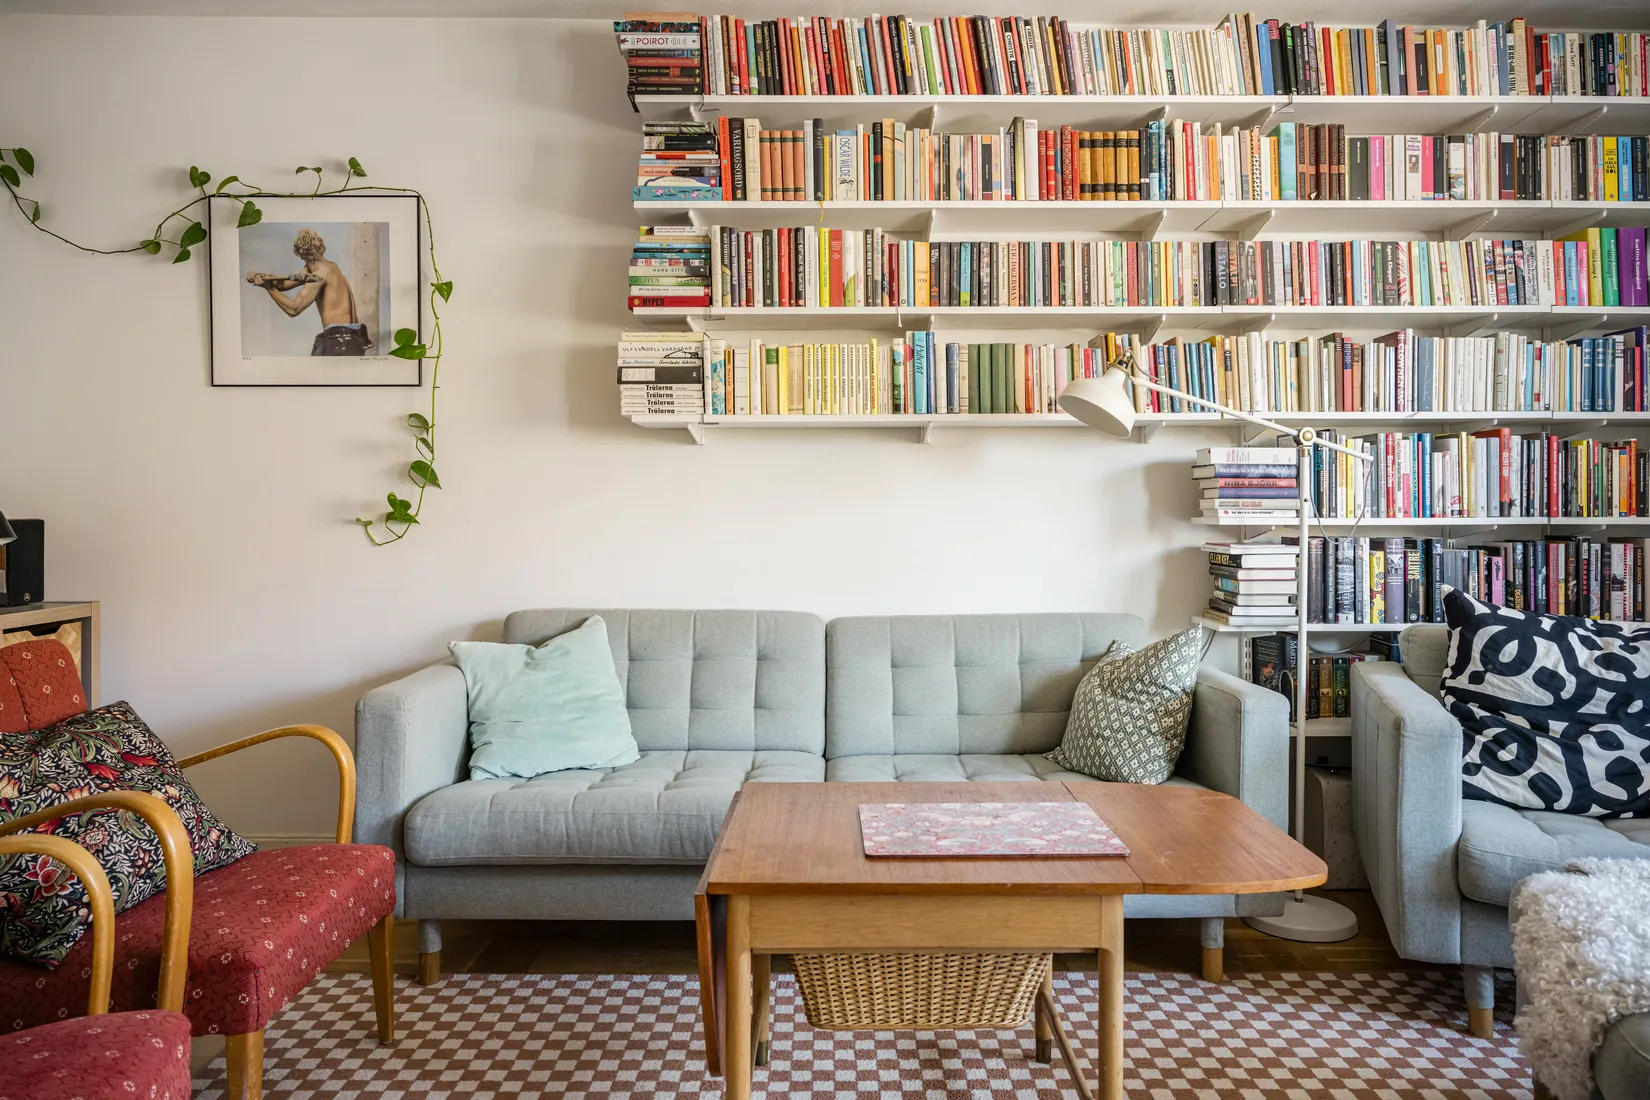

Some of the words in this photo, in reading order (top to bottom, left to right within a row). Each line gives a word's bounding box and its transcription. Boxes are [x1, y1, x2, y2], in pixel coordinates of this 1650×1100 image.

[733, 129, 742, 187] VARDAGSORD
[840, 137, 850, 158] OSCAR
[840, 159, 850, 177] WILDE
[642, 298, 664, 306] HYPER
[916, 344, 925, 375] Pubertet
[1210, 553, 1221, 564] ELLEN
[1408, 551, 1419, 579] SARTRE
